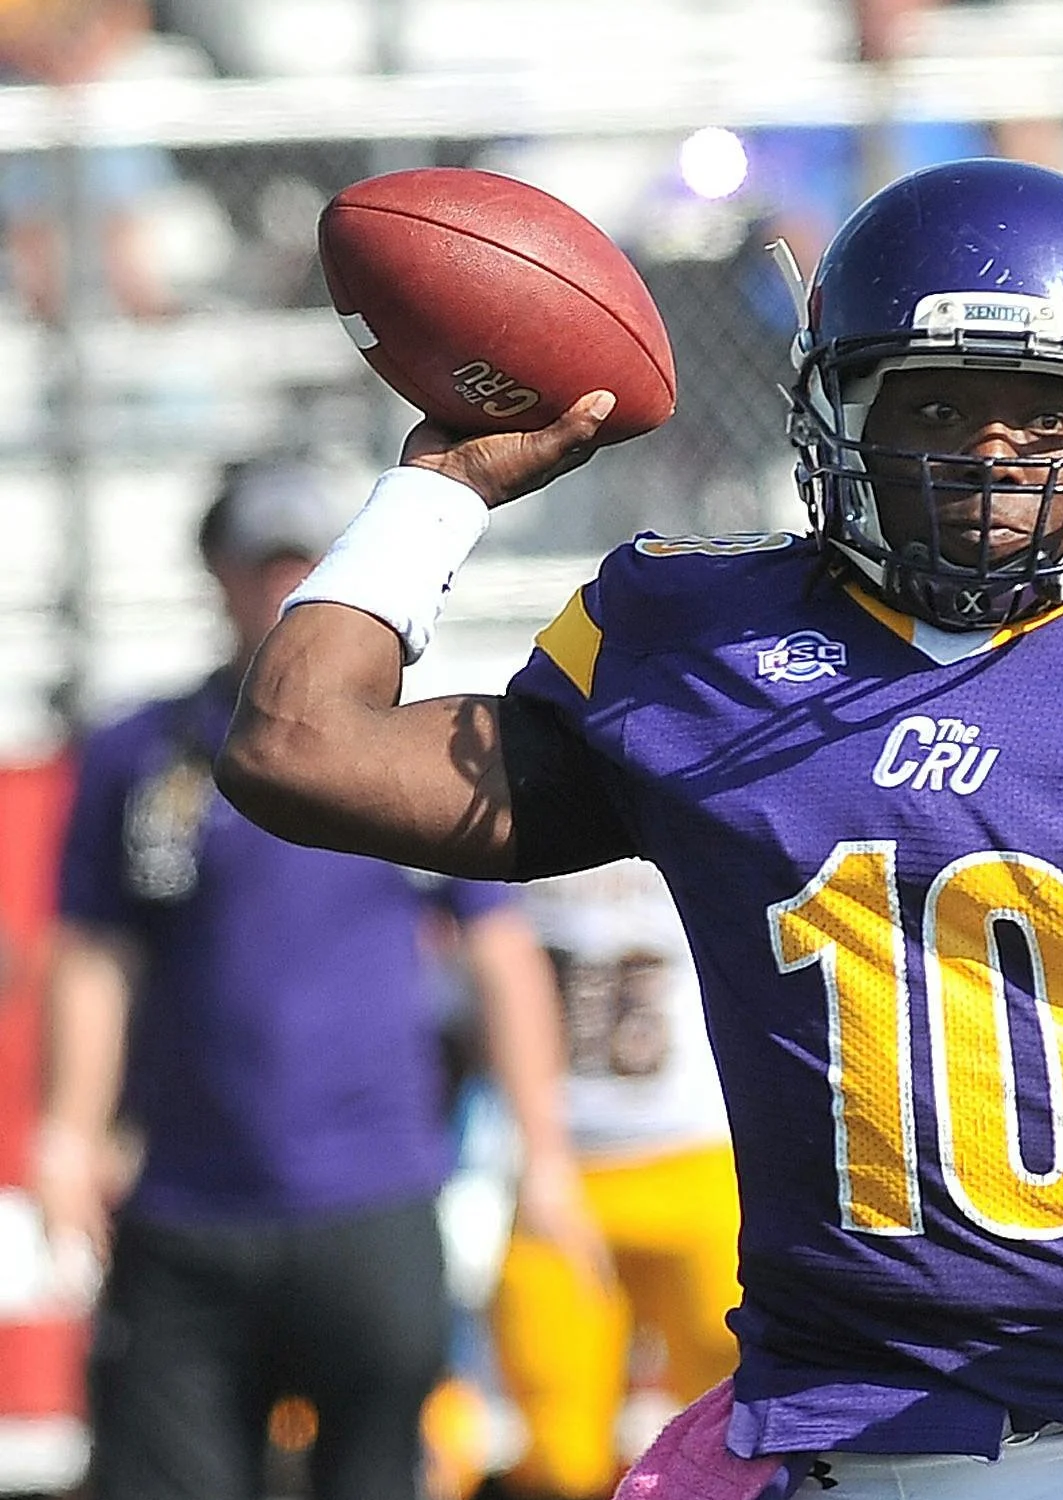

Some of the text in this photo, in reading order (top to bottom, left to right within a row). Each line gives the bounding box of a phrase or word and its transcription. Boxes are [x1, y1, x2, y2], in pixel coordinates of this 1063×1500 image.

[964, 305, 1023, 322] XENITH
[452, 360, 540, 419] CRU
[960, 590, 984, 614] X
[872, 715, 1001, 796] The CRU
